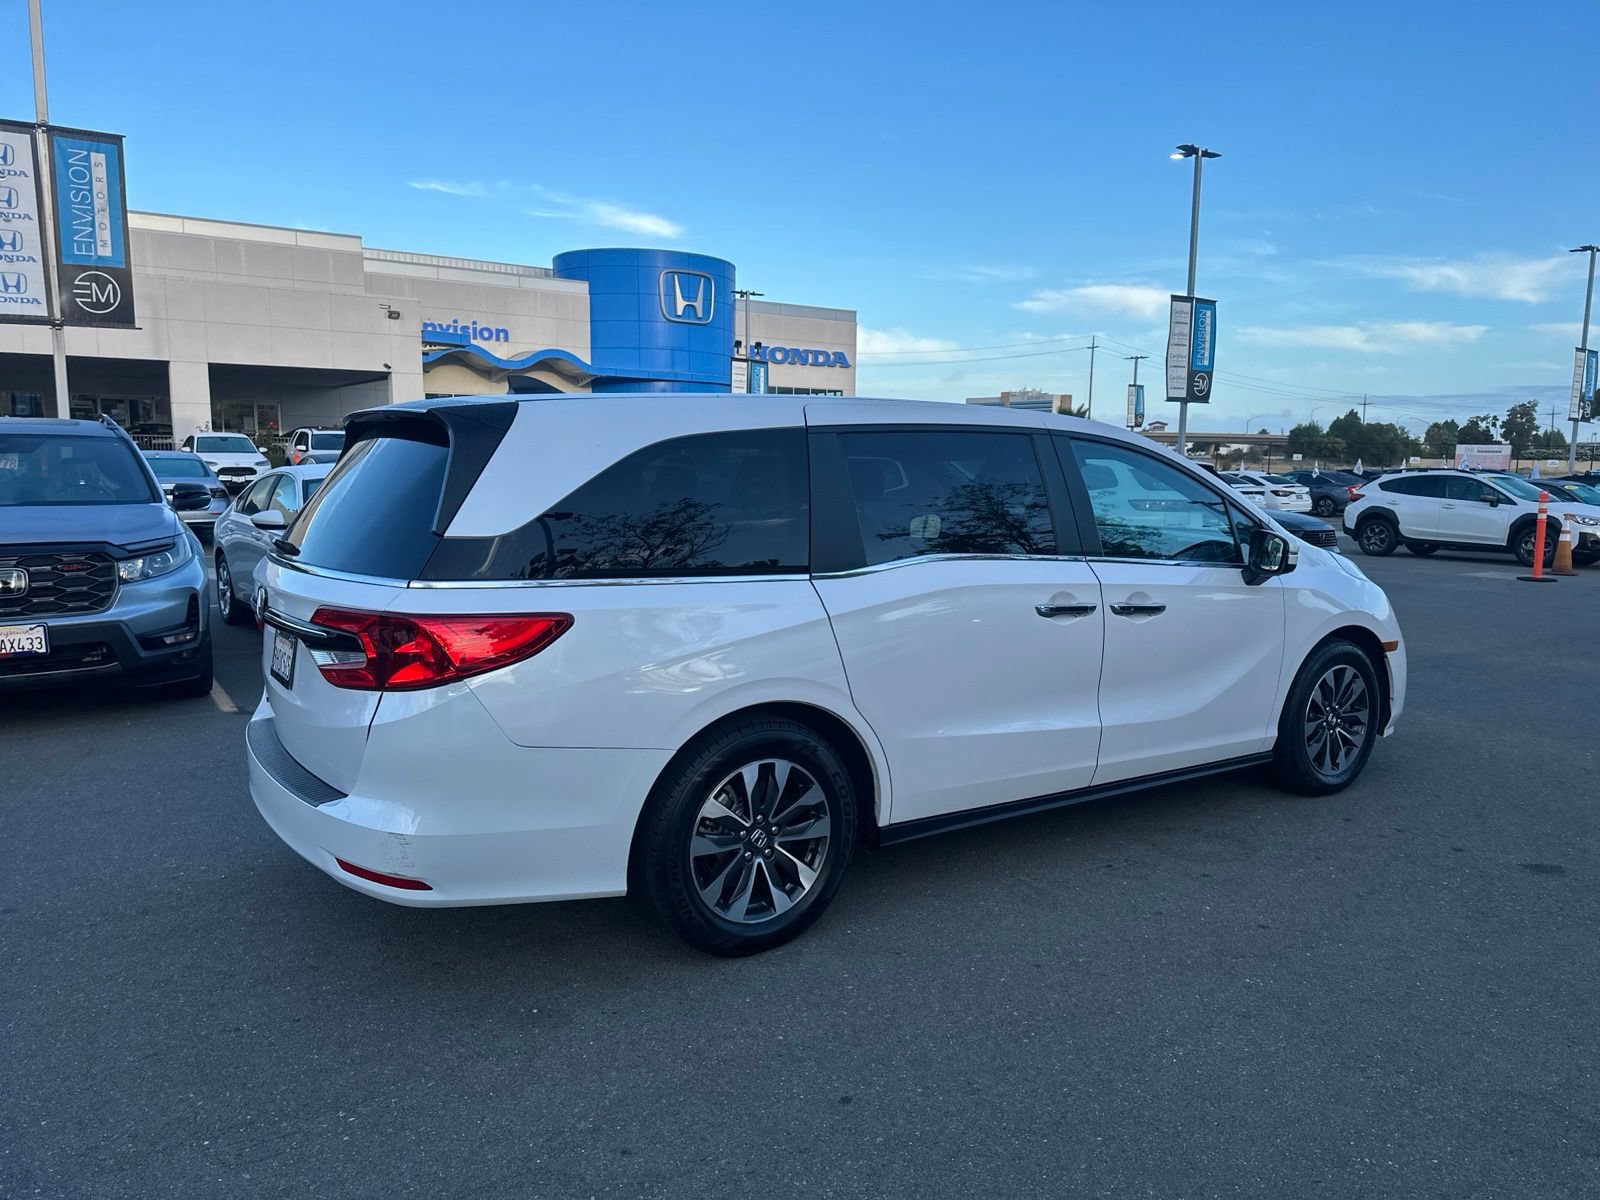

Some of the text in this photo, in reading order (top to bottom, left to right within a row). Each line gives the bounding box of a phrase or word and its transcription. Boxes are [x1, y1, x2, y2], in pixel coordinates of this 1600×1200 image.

[67, 149, 95, 255] ENVISION
[94, 161, 109, 248] MOTORS
[0, 254, 37, 263] NDA
[749, 344, 851, 368] HONDA
[1197, 309, 1207, 366] ENVISION
[0, 636, 43, 652] AX433
